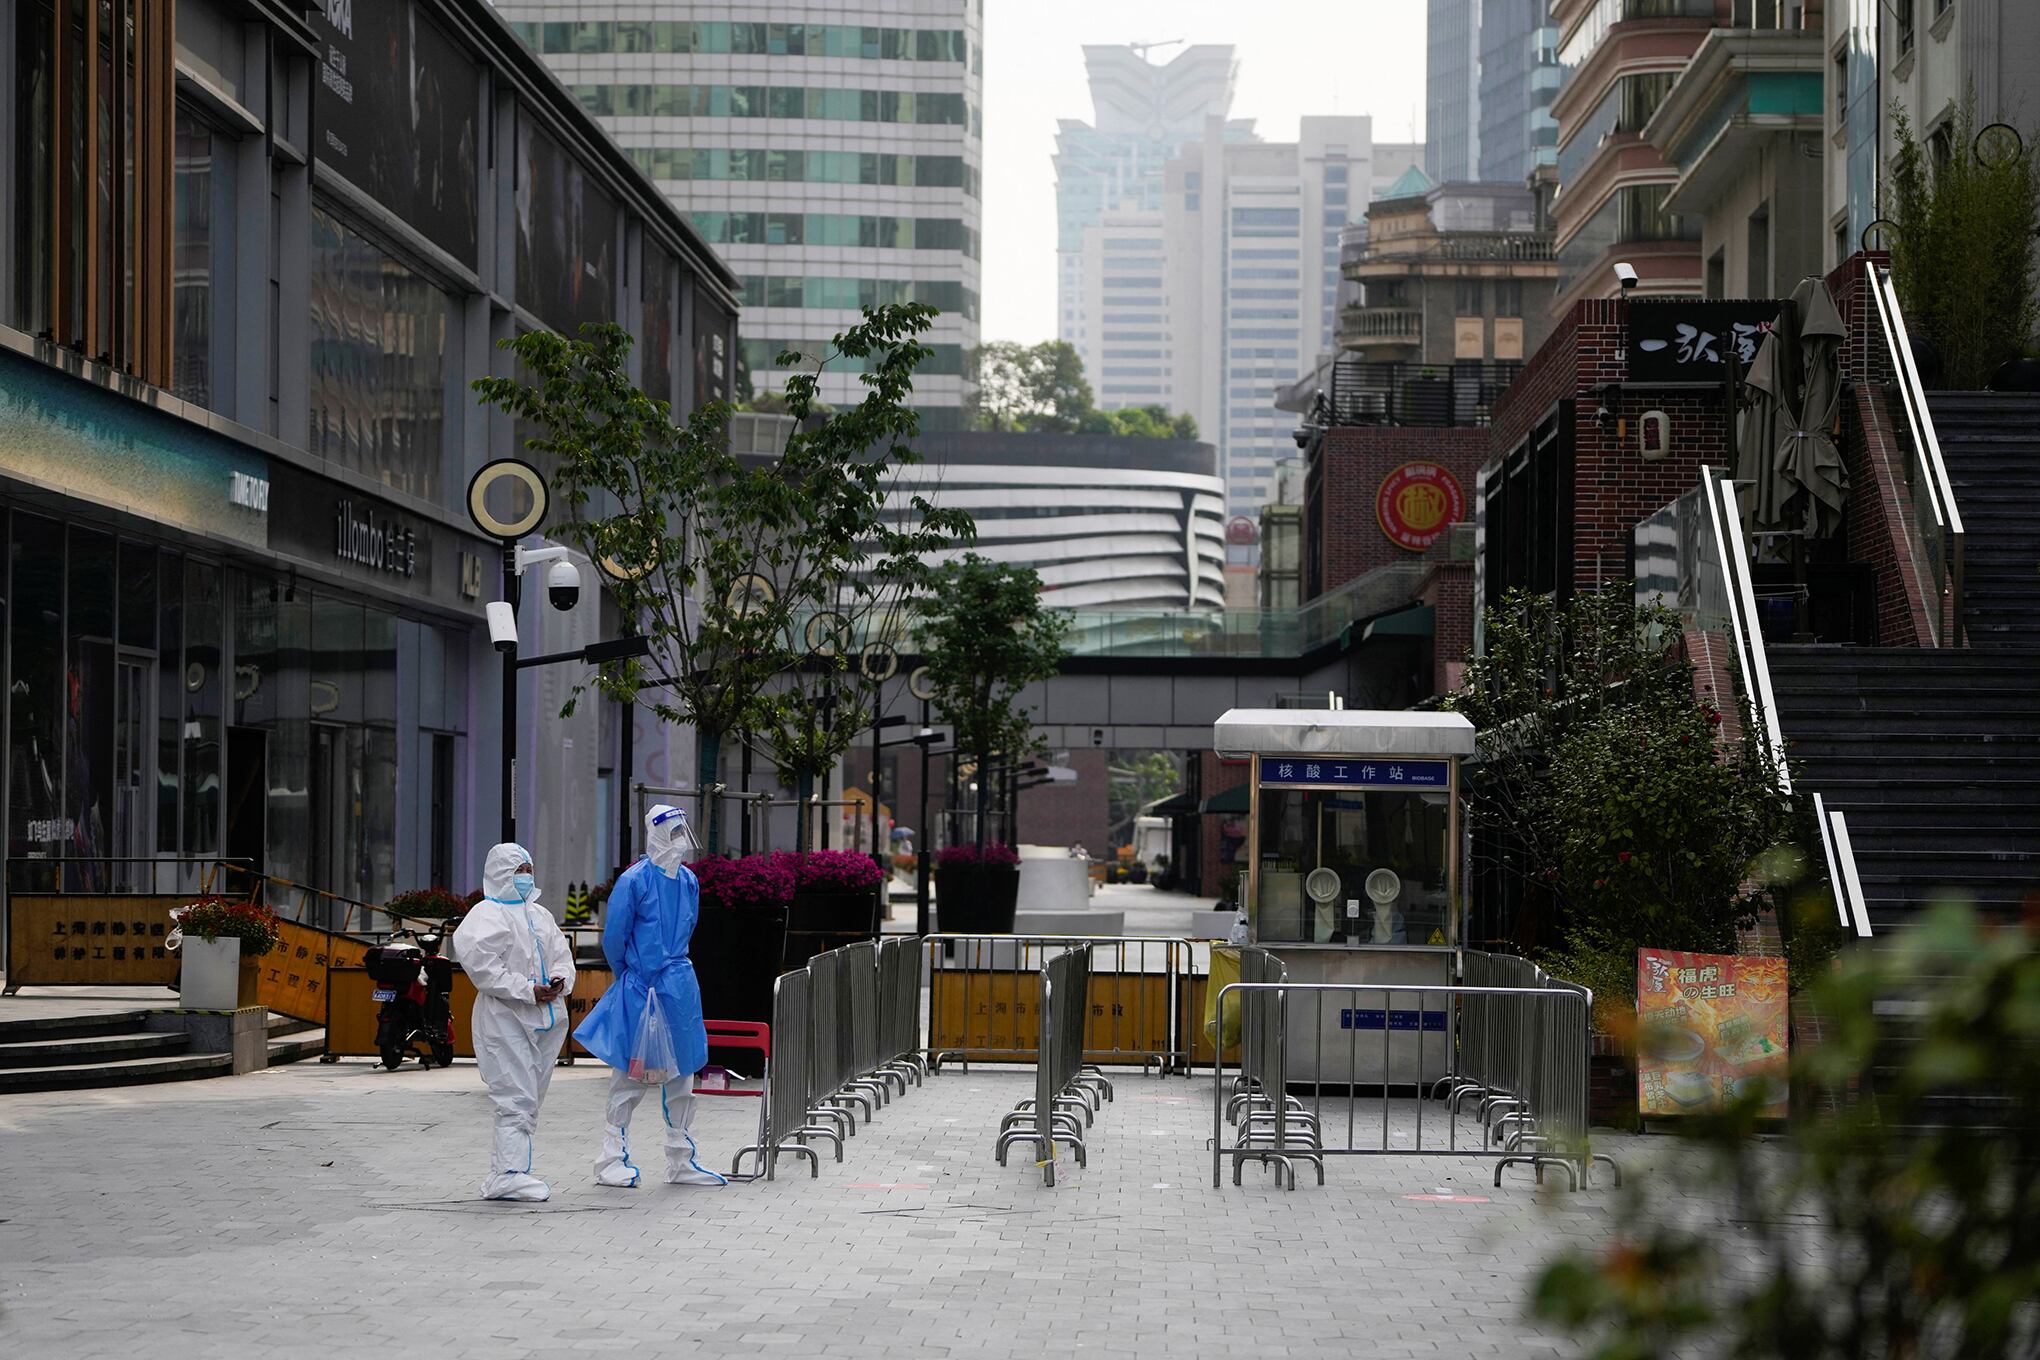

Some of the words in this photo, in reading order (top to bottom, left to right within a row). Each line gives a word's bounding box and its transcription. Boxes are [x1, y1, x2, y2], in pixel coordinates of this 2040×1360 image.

[337, 499, 385, 569] illombo
[462, 552, 481, 598] MLB
[1278, 763, 1404, 781] 核酸工作站
[277, 937, 365, 967] 市静安区
[258, 967, 321, 993] 工程有
[1678, 965, 1719, 984] 福虎
[1683, 983, 1737, 1000] の生旺
